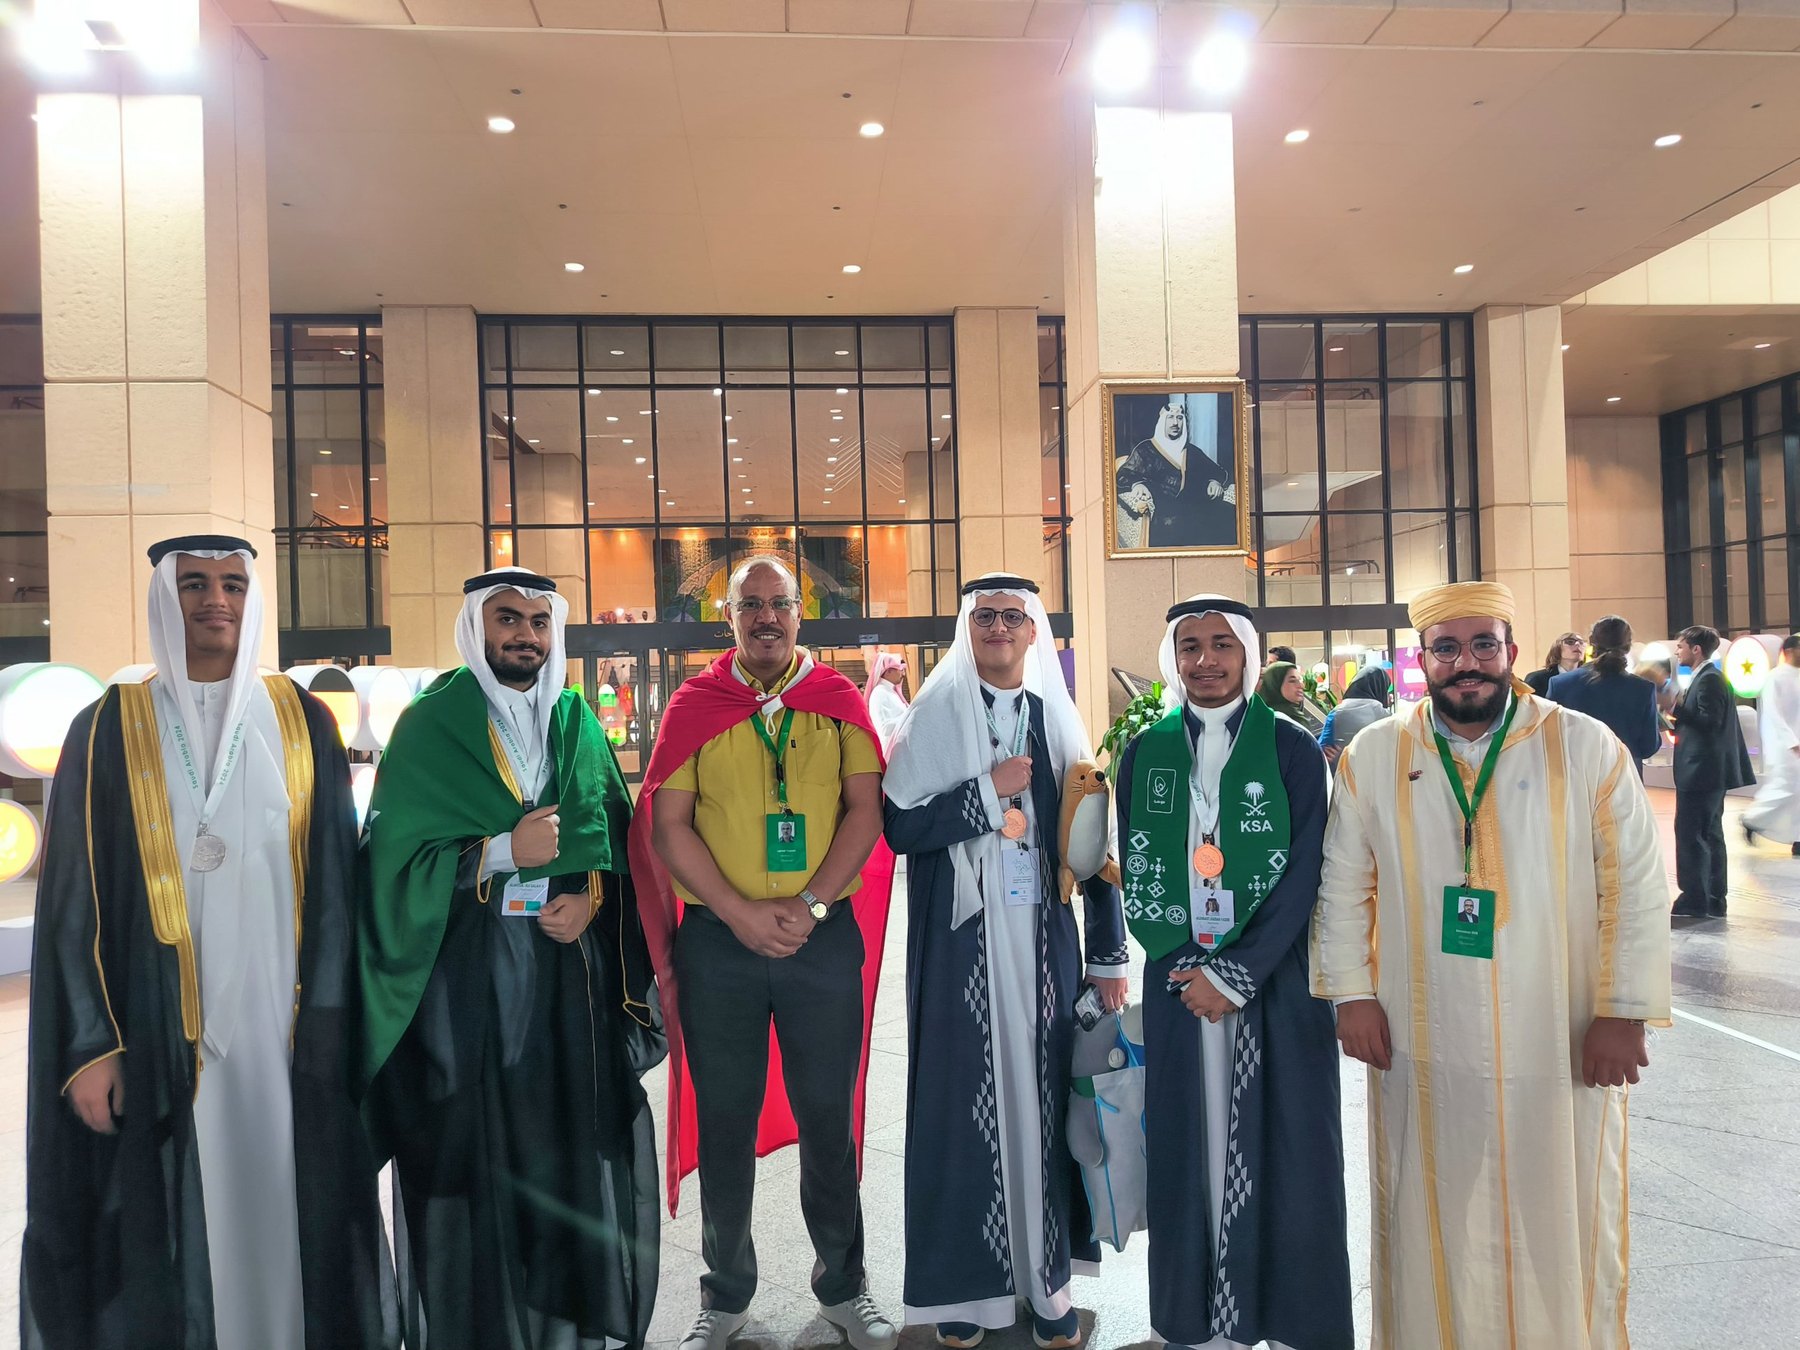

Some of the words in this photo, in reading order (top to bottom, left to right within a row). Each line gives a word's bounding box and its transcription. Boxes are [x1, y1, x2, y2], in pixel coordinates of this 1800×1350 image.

[174, 725, 185, 742] 2024
[496, 719, 508, 733] 2024
[505, 733, 519, 753] Arabia
[180, 743, 192, 767] Arabia
[225, 743, 237, 767] Arabia
[188, 769, 198, 789] Saudi
[219, 769, 229, 785] 2024
[1240, 819, 1274, 833] KSA
